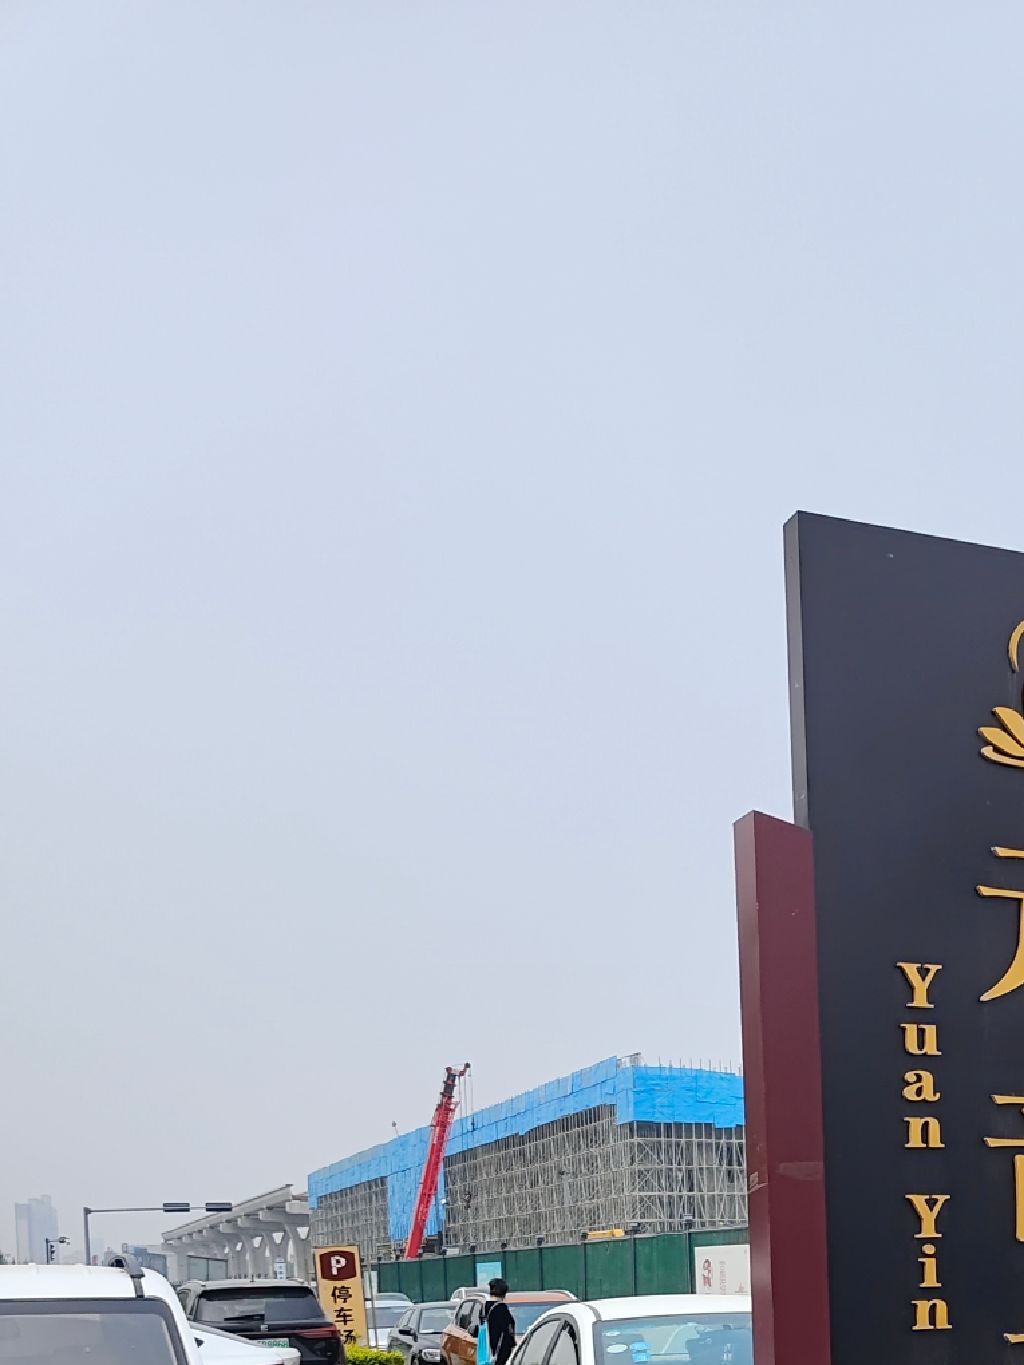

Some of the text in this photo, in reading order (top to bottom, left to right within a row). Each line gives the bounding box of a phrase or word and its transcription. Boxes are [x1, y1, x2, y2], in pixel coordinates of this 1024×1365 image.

[896, 962, 945, 1149] Yuan
[330, 1255, 347, 1276] P
[905, 1194, 952, 1331] Yin
